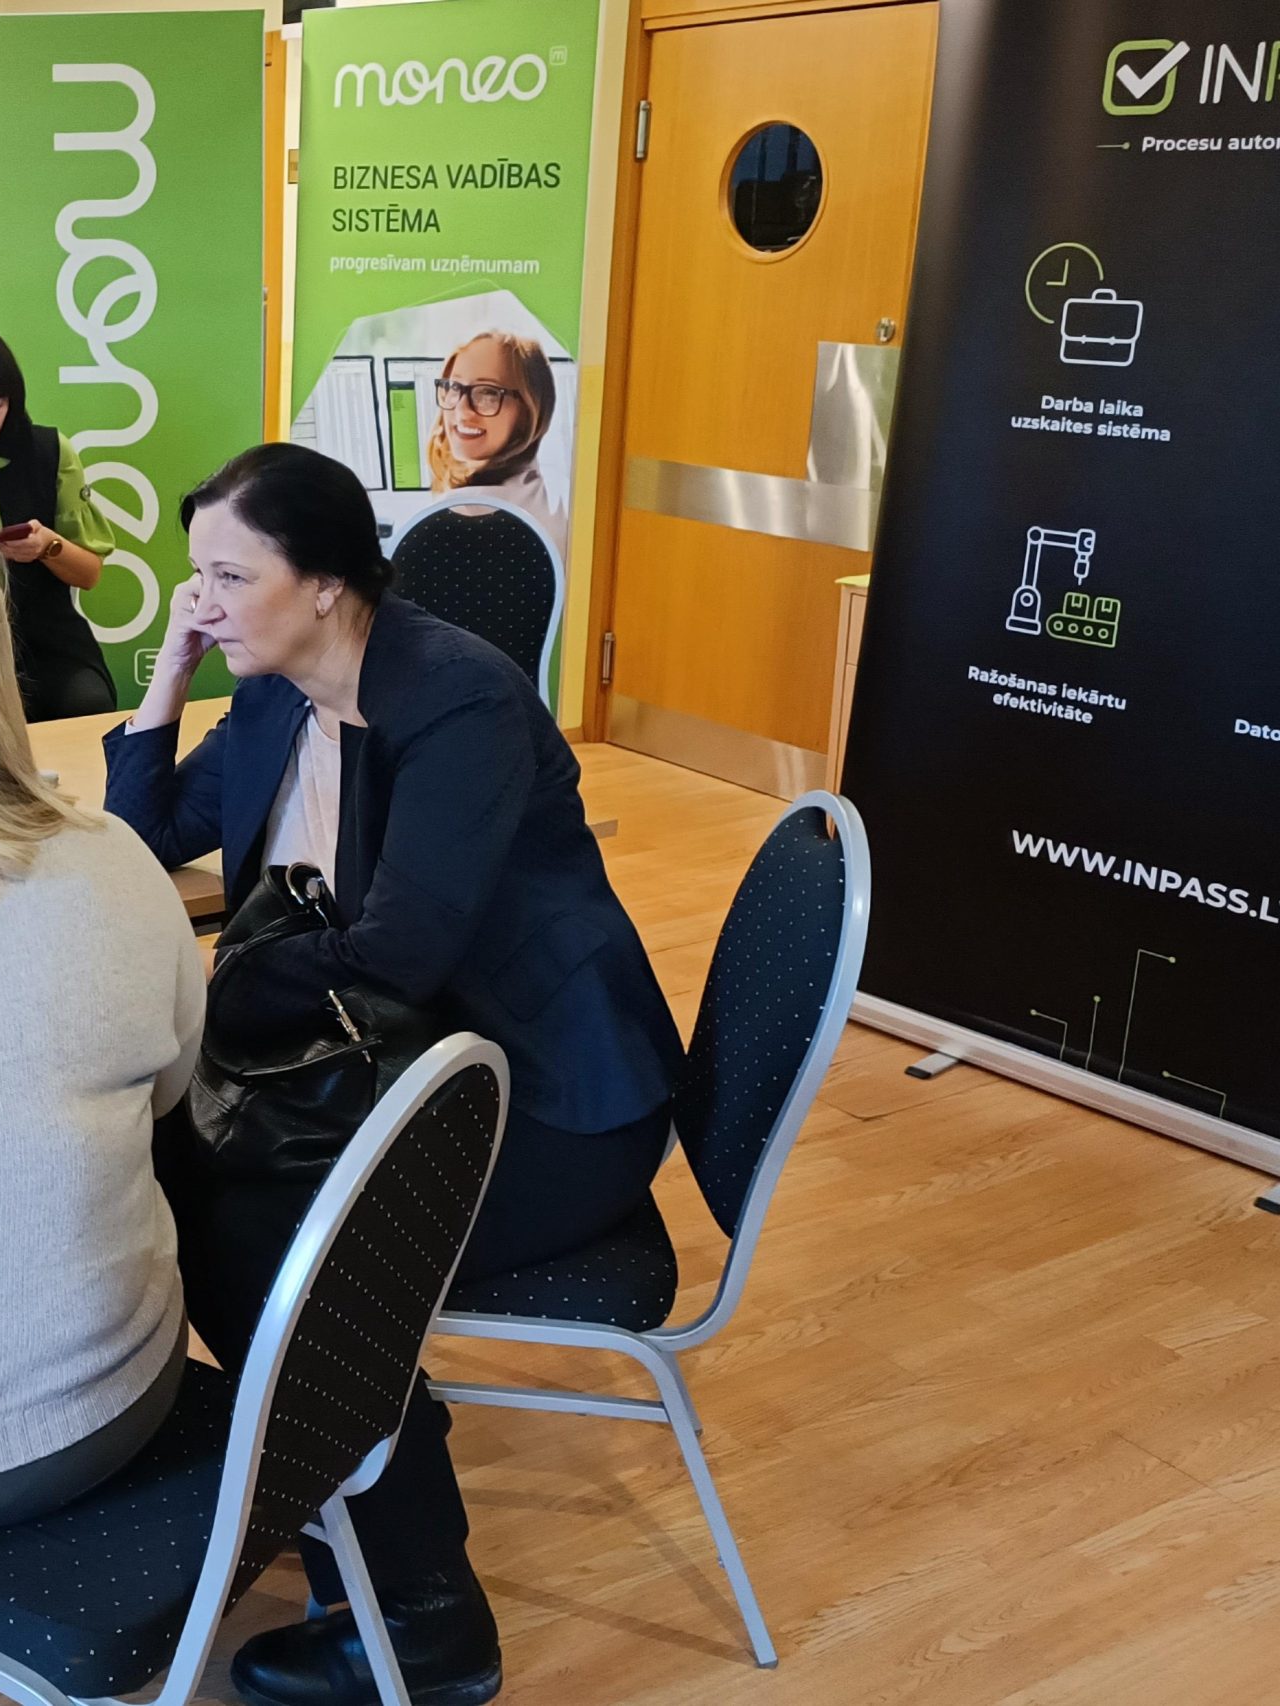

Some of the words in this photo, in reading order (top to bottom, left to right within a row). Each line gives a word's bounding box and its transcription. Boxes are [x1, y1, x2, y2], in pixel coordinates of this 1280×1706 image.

[334, 54, 547, 108] moneo
[1141, 136, 1221, 152] Procesu
[1228, 135, 1280, 151] auto
[333, 165, 439, 190] BIZNESA
[446, 158, 561, 189] VADĪBAS
[332, 204, 441, 233] SISTĒMA
[330, 254, 426, 274] progresīvam
[431, 255, 540, 276] uzņēmumam
[1041, 395, 1094, 413] Darba
[1099, 399, 1144, 417] laika
[1011, 415, 1093, 434] uzskaites
[1097, 421, 1171, 442] sistēma
[968, 665, 1058, 696] Ražošanas
[1061, 683, 1127, 710] iekārtu
[992, 692, 1093, 724] efektivitāte
[1012, 829, 1280, 923] WWW.INPASS.L
